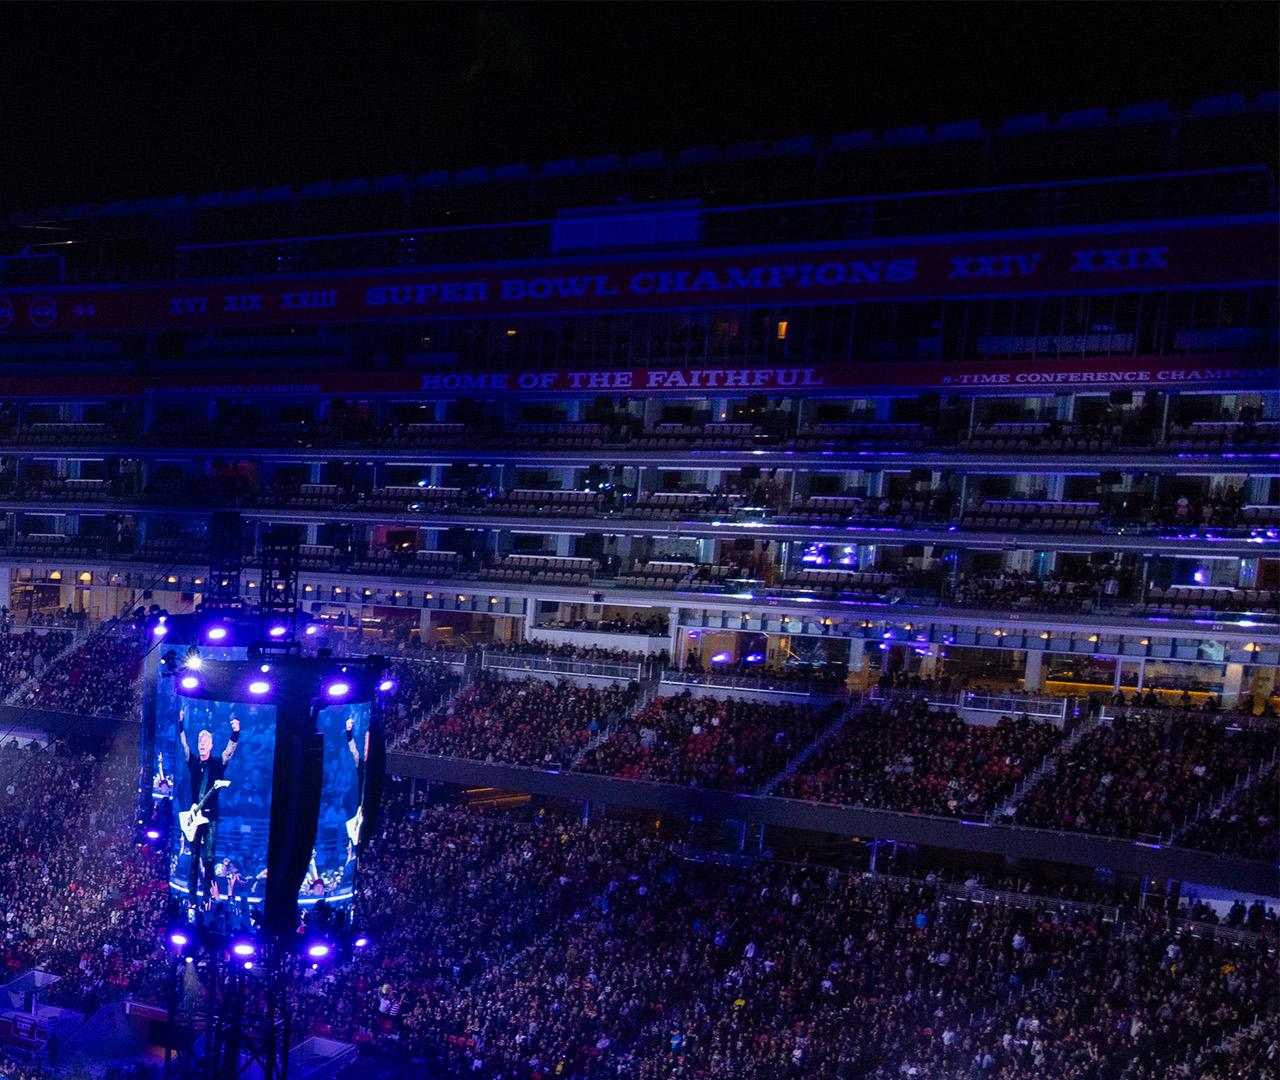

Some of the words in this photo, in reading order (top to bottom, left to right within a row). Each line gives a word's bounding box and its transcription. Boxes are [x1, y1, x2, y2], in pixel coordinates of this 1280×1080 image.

[366, 281, 489, 305] SUPER
[500, 275, 620, 301] BOWL
[629, 258, 918, 294] CHAMPIONS
[948, 252, 1042, 280] XXIV
[1071, 246, 1169, 273] XXIX
[421, 373, 508, 389] HOME
[518, 373, 558, 389] OF
[567, 371, 633, 388] THE
[646, 368, 824, 387] FAITHFUL
[1015, 371, 1151, 383] CONFERENCE
